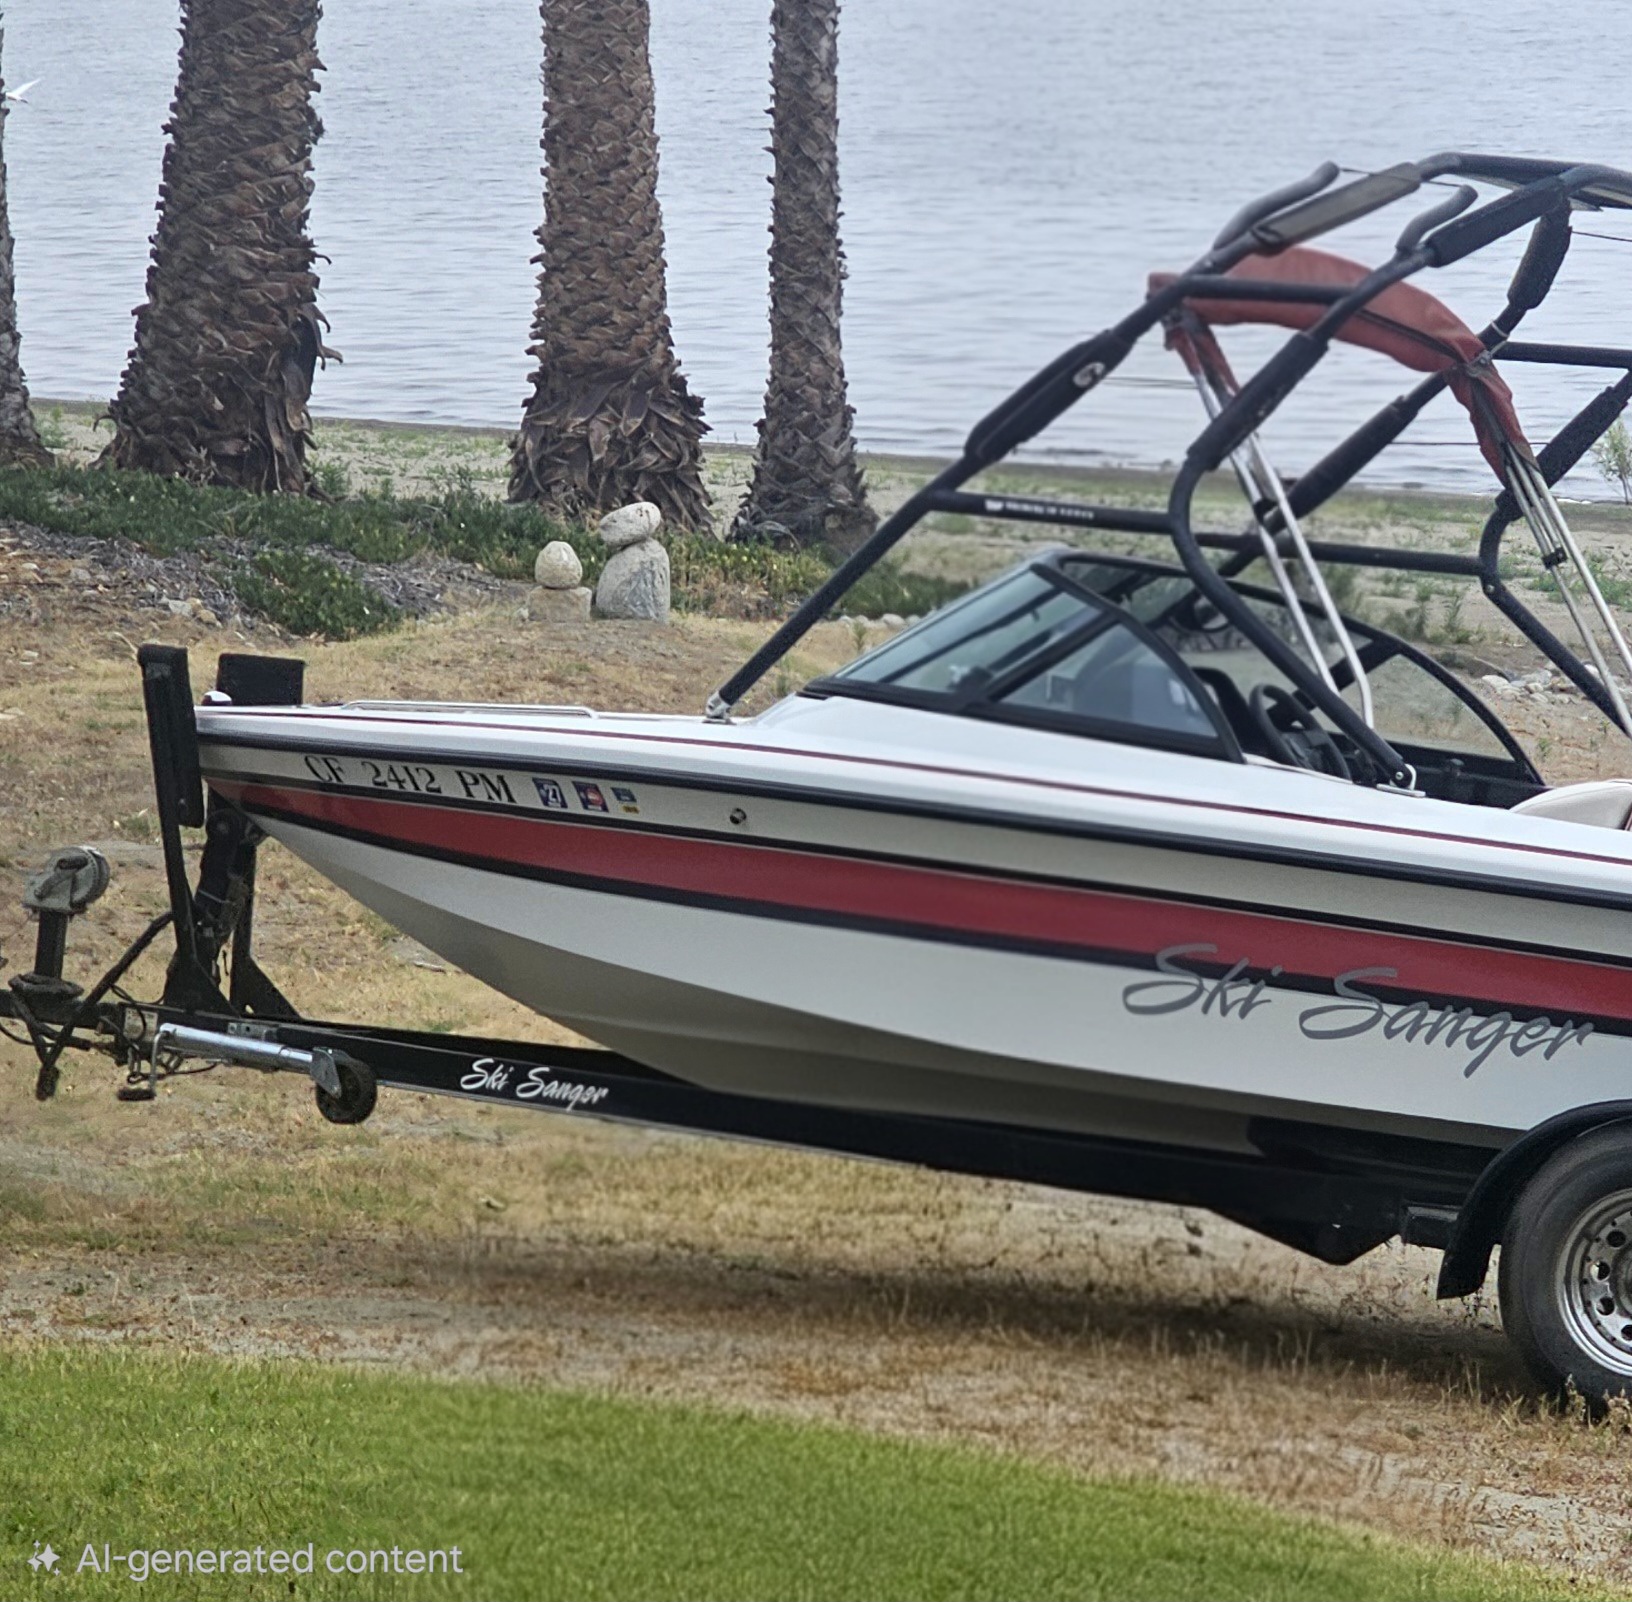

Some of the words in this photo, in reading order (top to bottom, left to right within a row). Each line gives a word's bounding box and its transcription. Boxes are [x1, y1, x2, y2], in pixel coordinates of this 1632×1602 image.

[303, 755, 345, 783] CF
[361, 761, 442, 794] 2412
[455, 769, 518, 804] PM
[1122, 943, 1283, 1020] Ski
[1299, 967, 1594, 1078] Sanger
[460, 1058, 515, 1090] Ski
[516, 1066, 609, 1112] Sanger
